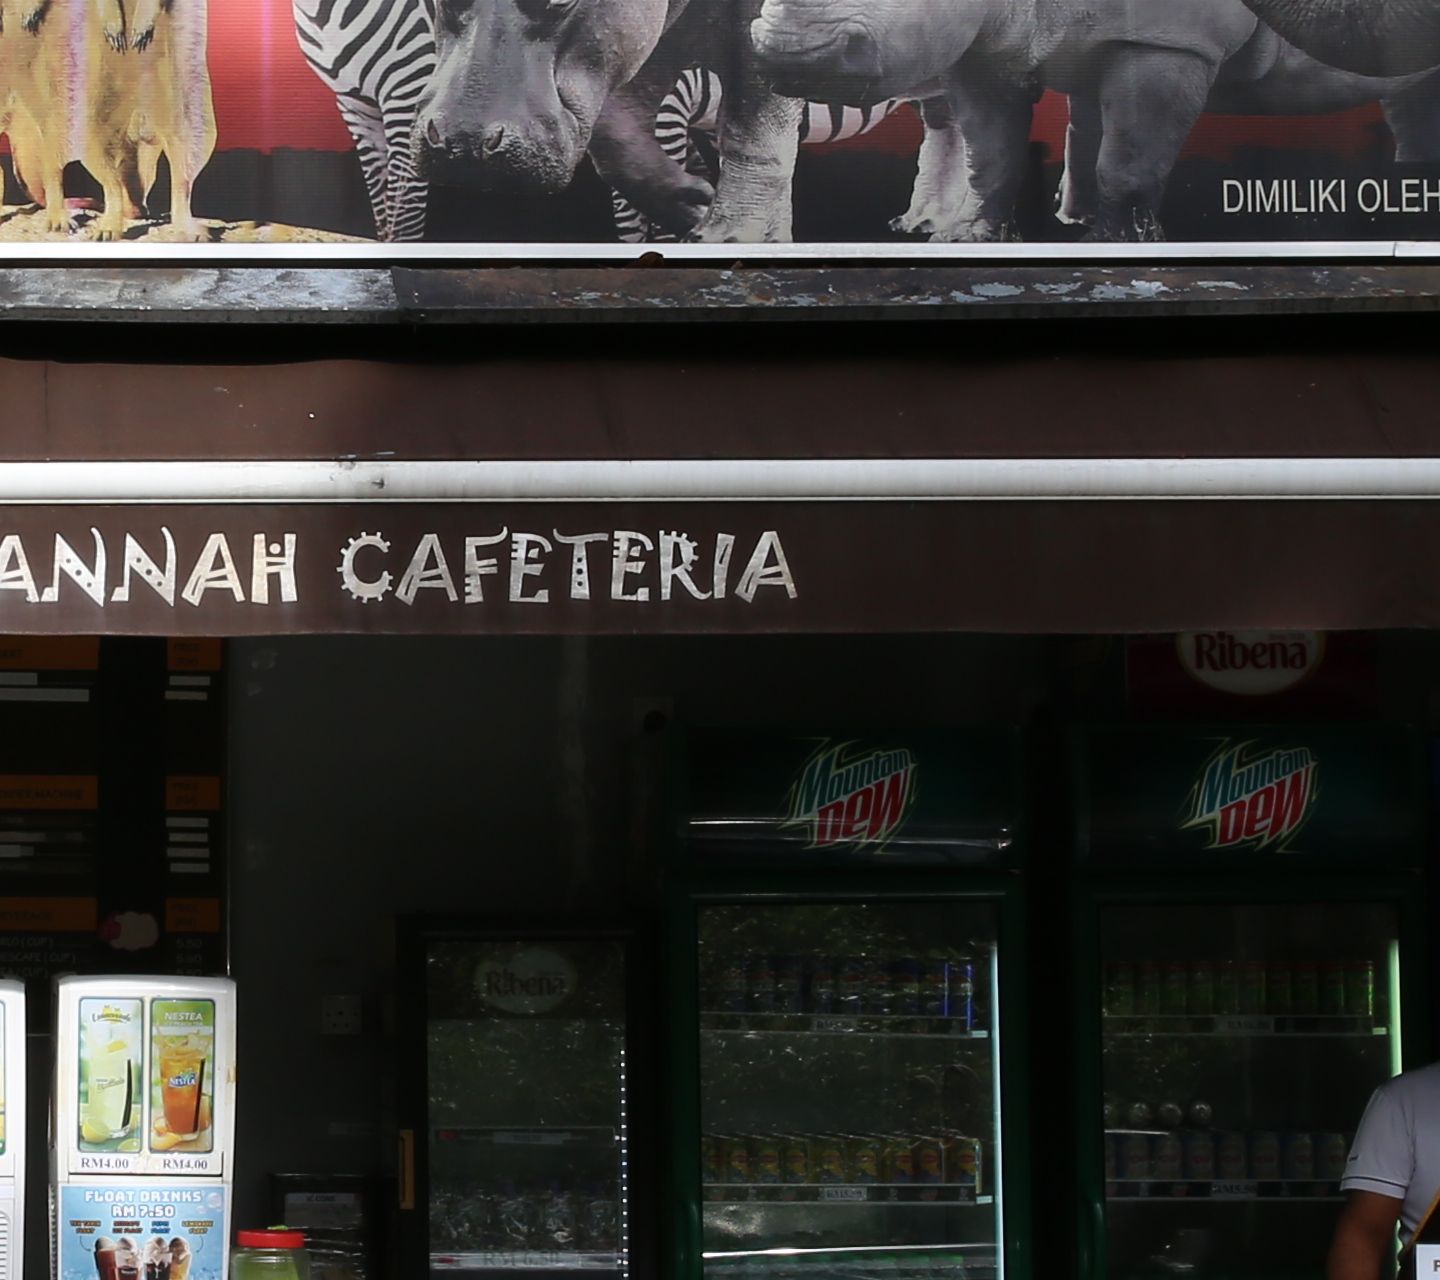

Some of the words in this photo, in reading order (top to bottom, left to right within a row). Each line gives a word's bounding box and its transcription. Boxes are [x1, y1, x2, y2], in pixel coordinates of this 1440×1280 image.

[1222, 178, 1348, 214] DIMILIKI
[336, 526, 799, 604] CAFETERIA
[1194, 631, 1308, 671] Ribena
[793, 747, 911, 820] Mountain
[1196, 746, 1314, 819] Mountain
[164, 1011, 204, 1021] NESTEA
[80, 1157, 130, 1169] RM4.00
[162, 1158, 208, 1170] RM4.00
[84, 1190, 135, 1203] FLOAT
[140, 1190, 202, 1203] DRINKS
[112, 1204, 136, 1217] RM
